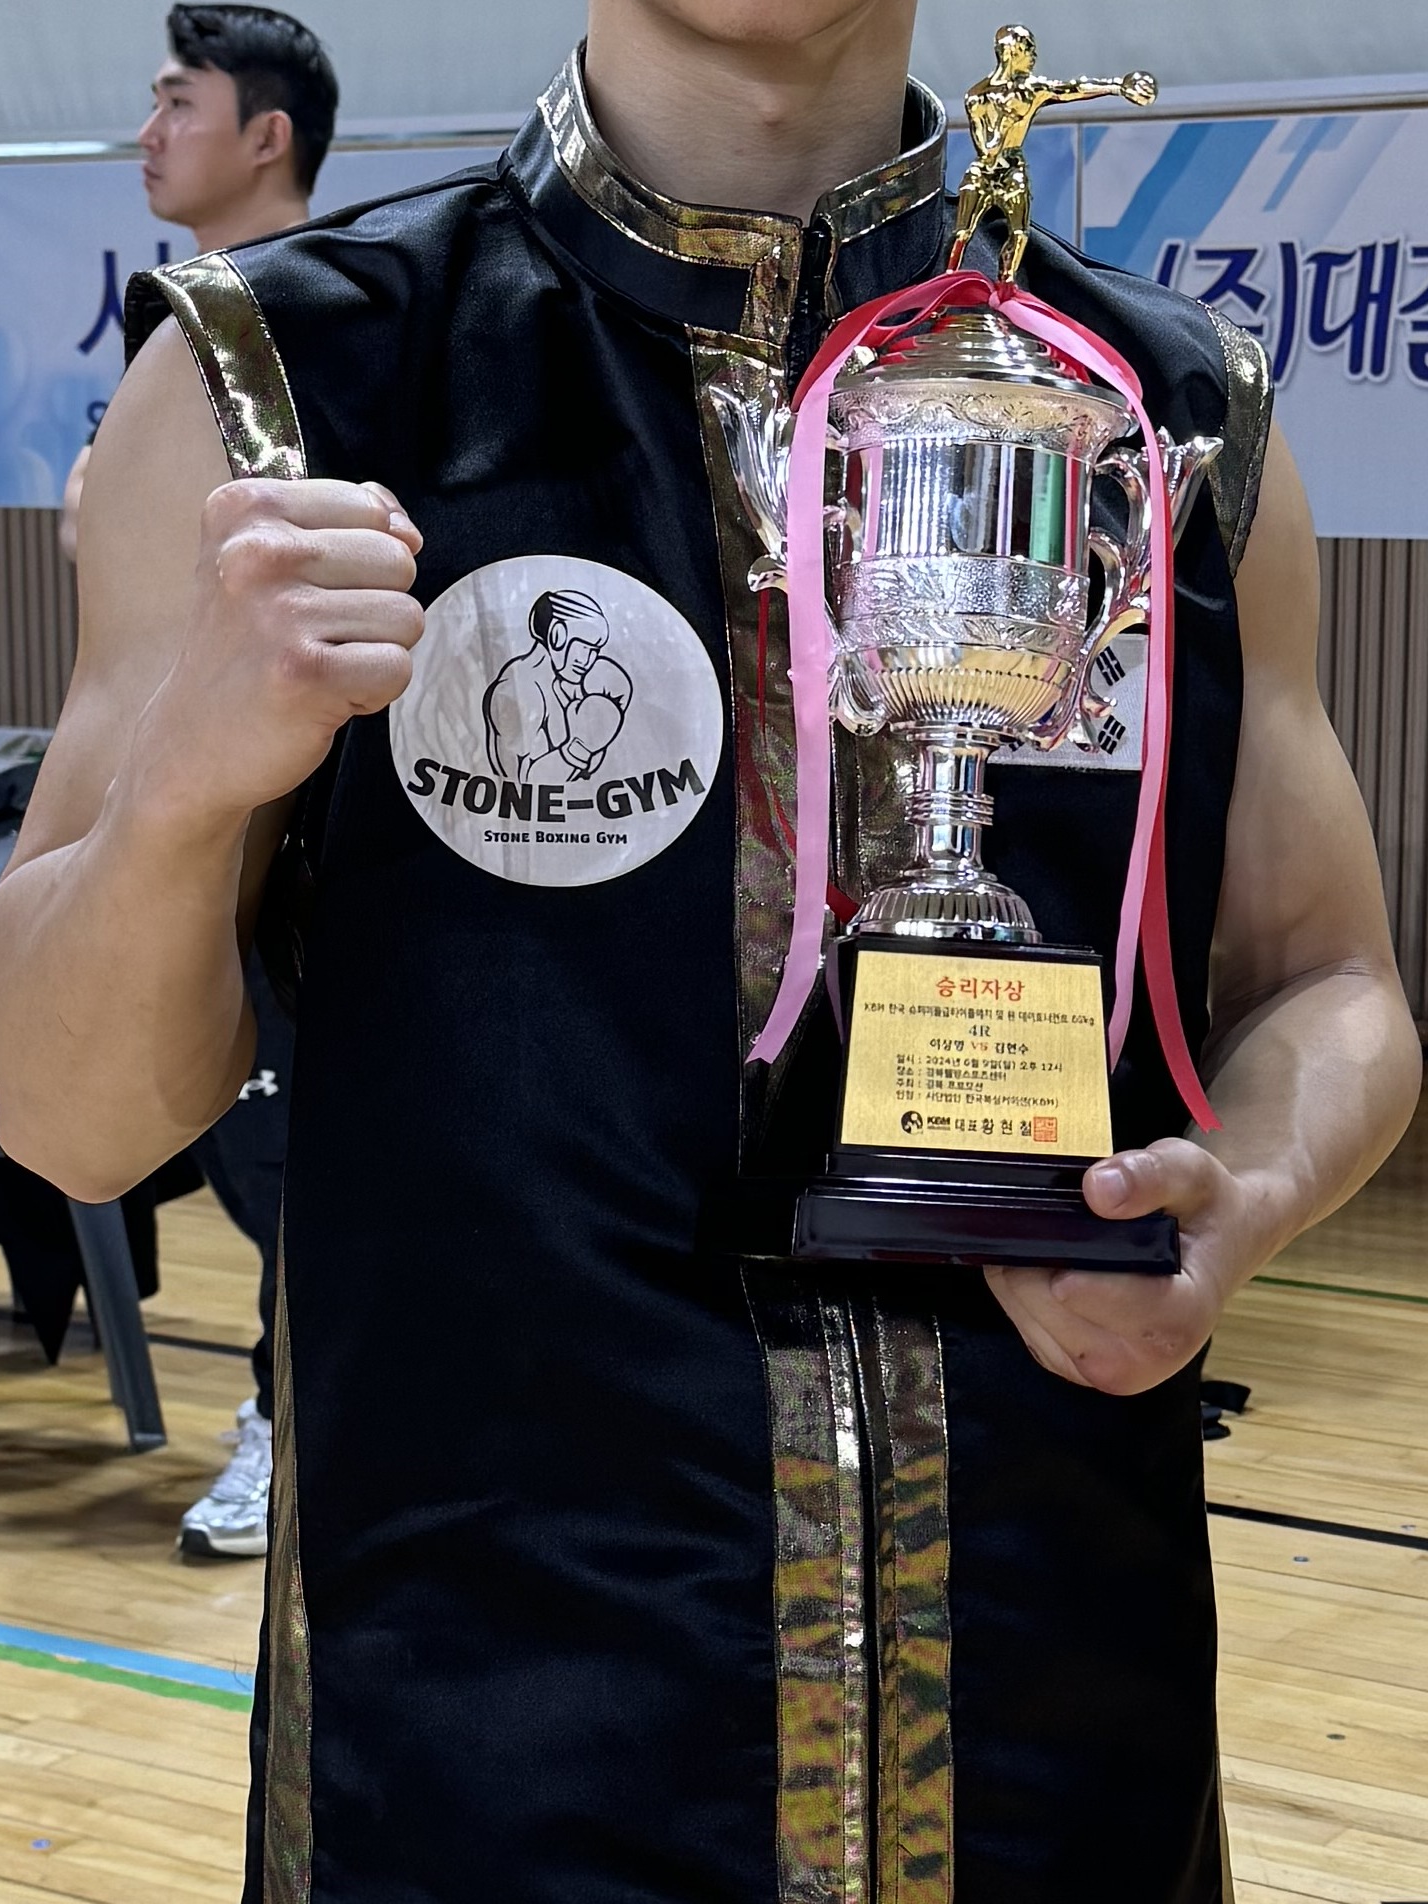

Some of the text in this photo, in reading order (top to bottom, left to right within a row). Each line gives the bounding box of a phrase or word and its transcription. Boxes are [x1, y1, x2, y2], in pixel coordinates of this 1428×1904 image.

[407, 758, 706, 823] STONE-GYM
[935, 976, 1026, 1002] 승리자상
[968, 1024, 991, 1037] 4R
[896, 1054, 914, 1065] 일시
[926, 1055, 961, 1067] 2024년
[1019, 1061, 1037, 1071] 오후
[1041, 1063, 1063, 1073] 12시
